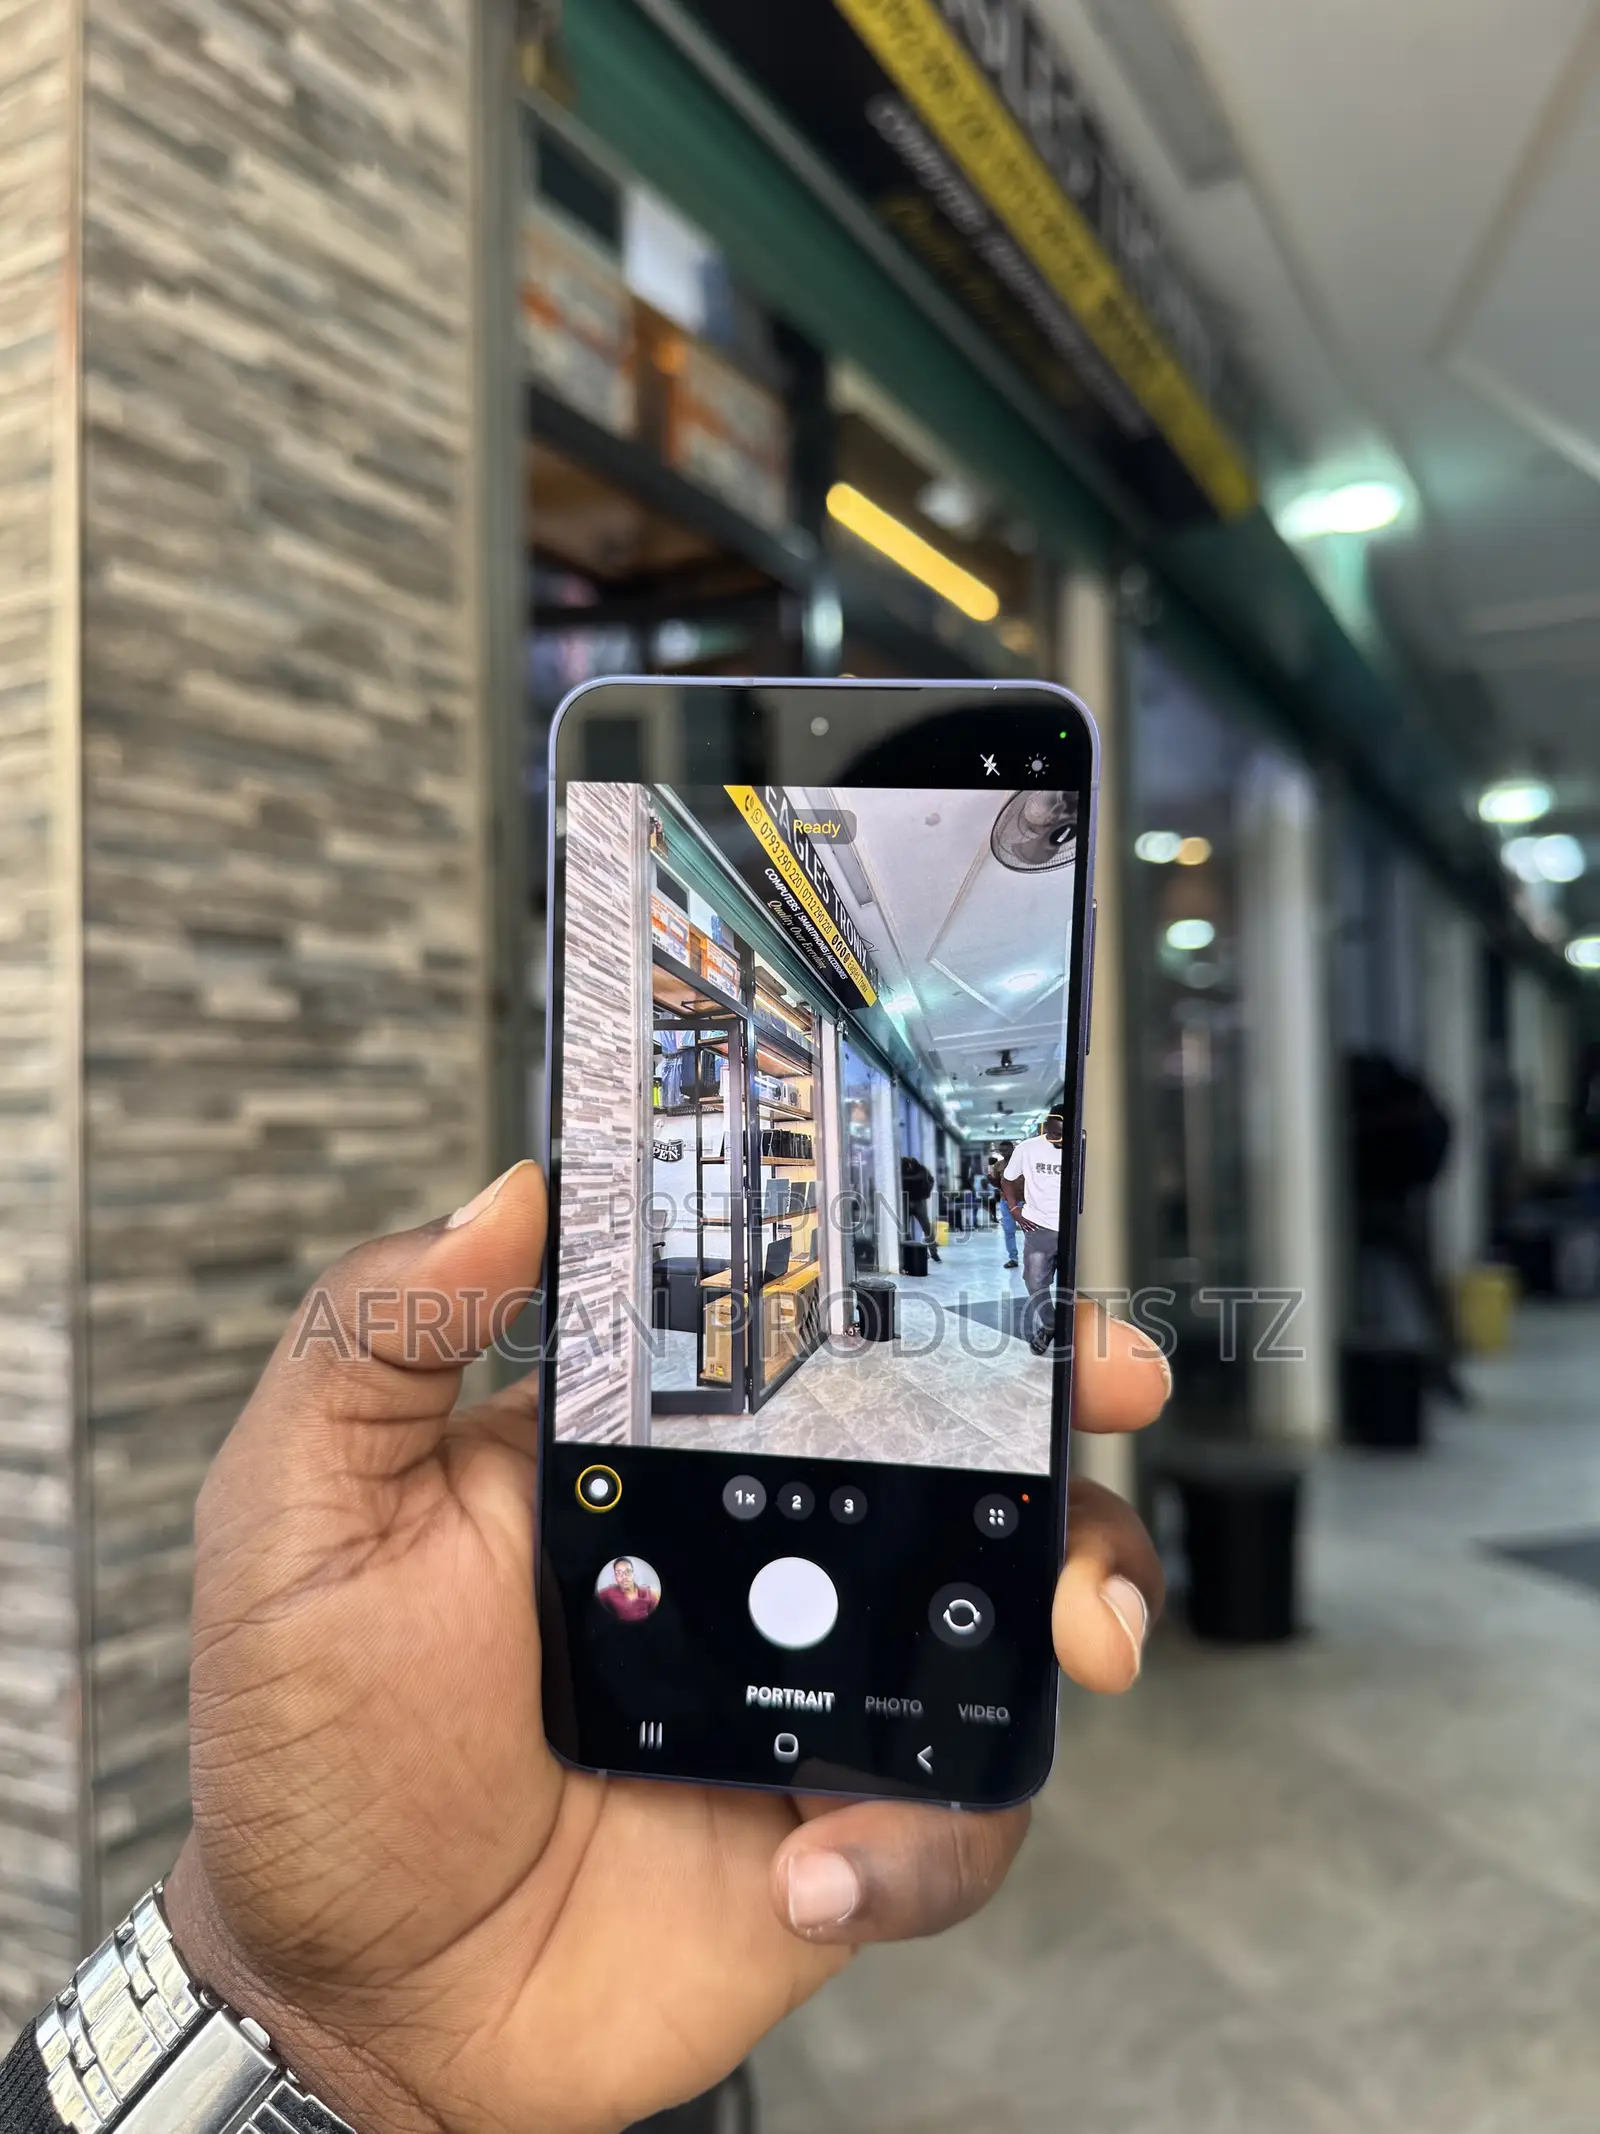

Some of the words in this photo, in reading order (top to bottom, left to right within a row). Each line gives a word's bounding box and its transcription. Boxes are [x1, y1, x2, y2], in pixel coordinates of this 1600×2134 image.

[793, 819, 841, 838] Ready
[760, 822, 781, 854] 0793
[777, 849, 792, 873] 290
[788, 867, 803, 889] 220
[764, 867, 801, 913] COMPUTERS
[767, 899, 795, 927] Quality
[735, 1489, 756, 1506] 1x
[791, 1495, 802, 1511] 2
[843, 1498, 855, 1514] 3
[746, 1685, 835, 1713] PORTRAIT
[865, 1695, 924, 1719] PHOTO
[957, 1703, 1011, 1727] VIDEO
